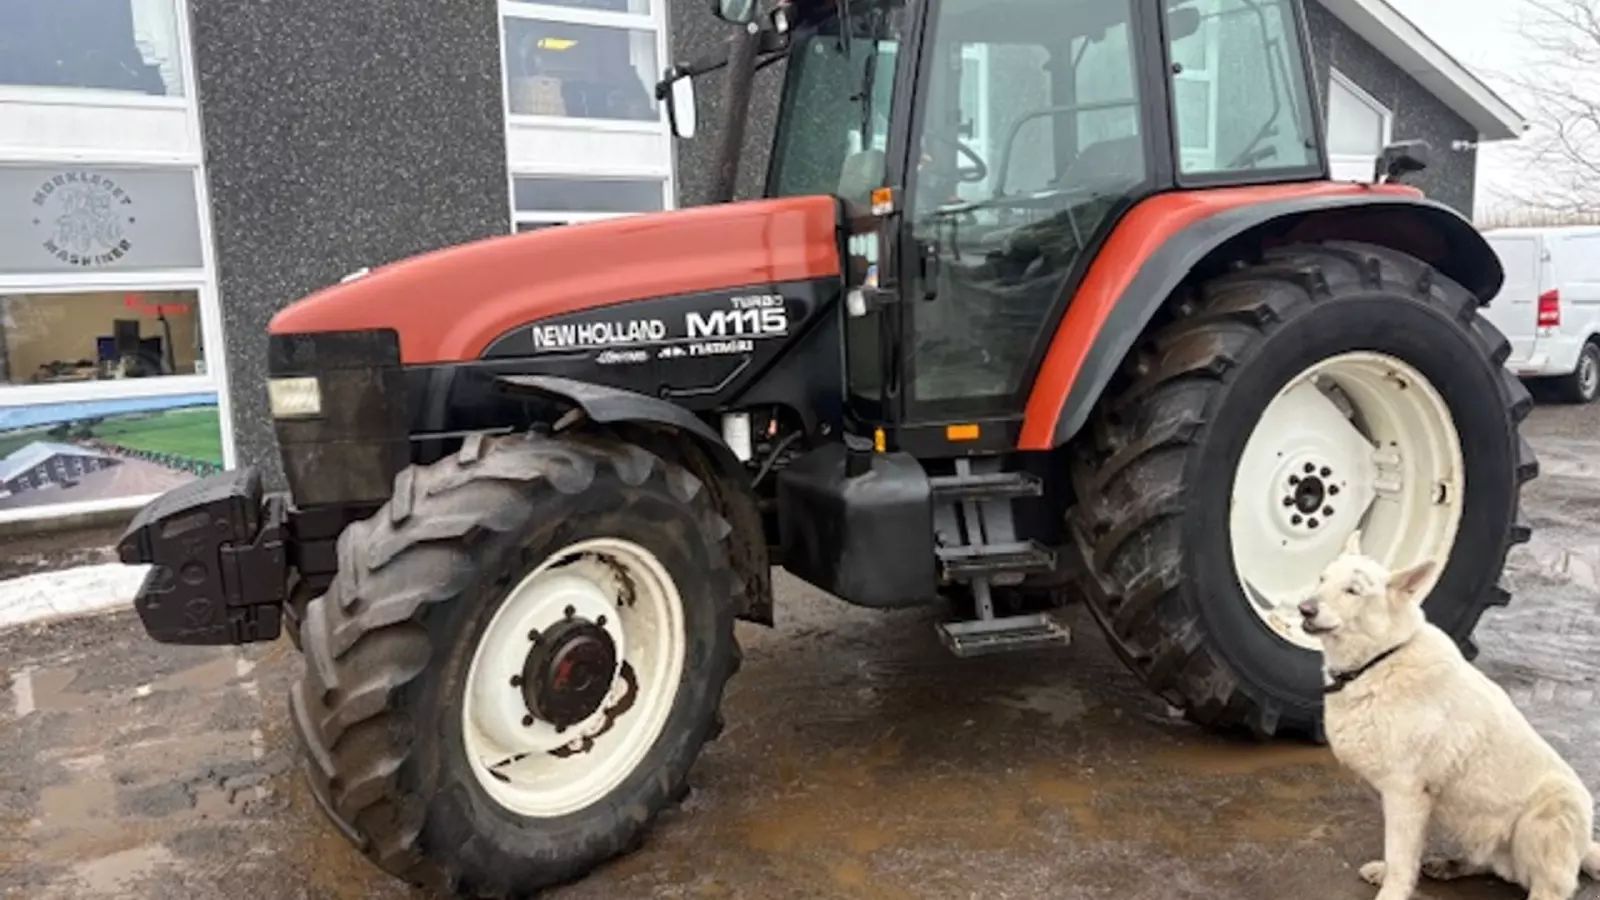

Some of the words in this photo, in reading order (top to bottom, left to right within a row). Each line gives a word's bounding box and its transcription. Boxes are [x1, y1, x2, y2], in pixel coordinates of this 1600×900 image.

[730, 295, 783, 309] TURBO
[532, 326, 575, 348] NEW
[578, 319, 666, 345] HOLLAND
[686, 308, 787, 338] M115
